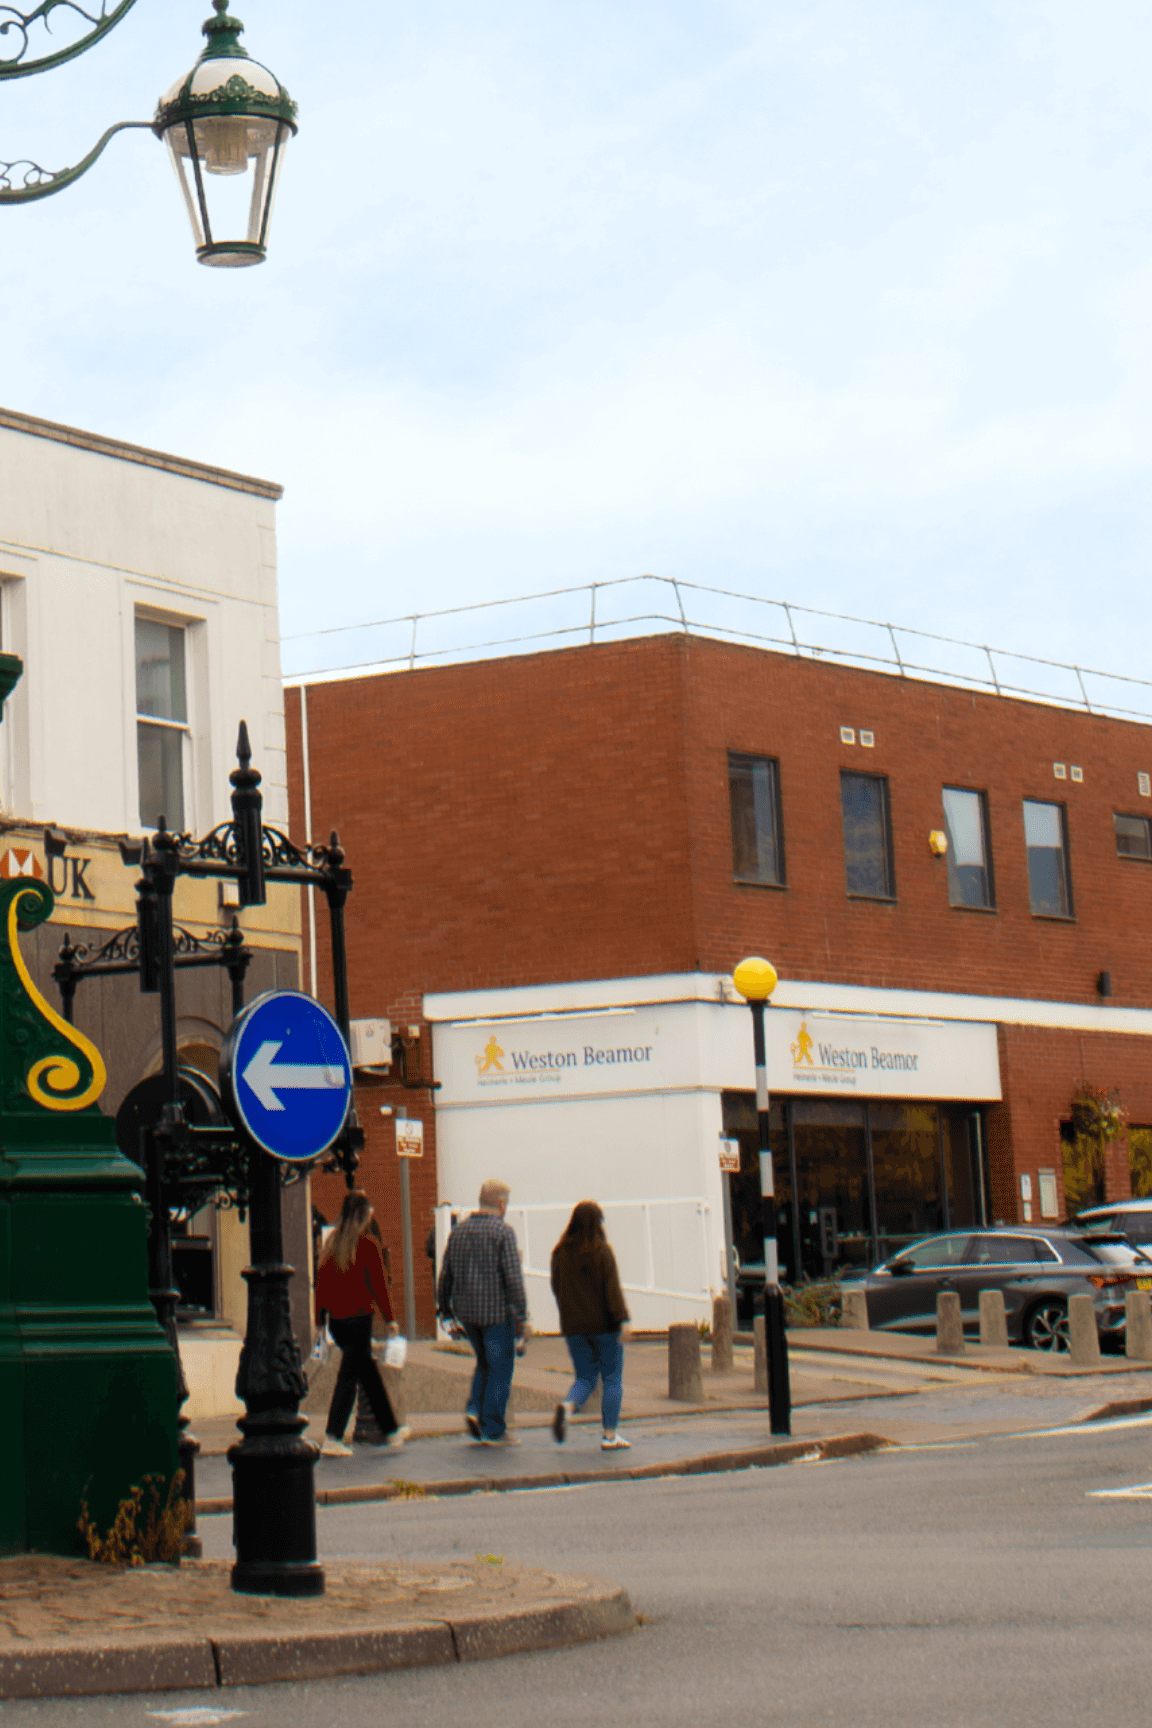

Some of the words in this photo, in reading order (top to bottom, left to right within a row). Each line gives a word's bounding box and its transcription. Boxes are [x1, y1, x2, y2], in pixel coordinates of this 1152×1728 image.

[48, 855, 96, 900] UK
[511, 1050, 577, 1070] Weston
[583, 1046, 654, 1066] Beamor
[818, 1042, 868, 1069] Weston
[870, 1046, 919, 1071] Beamor
